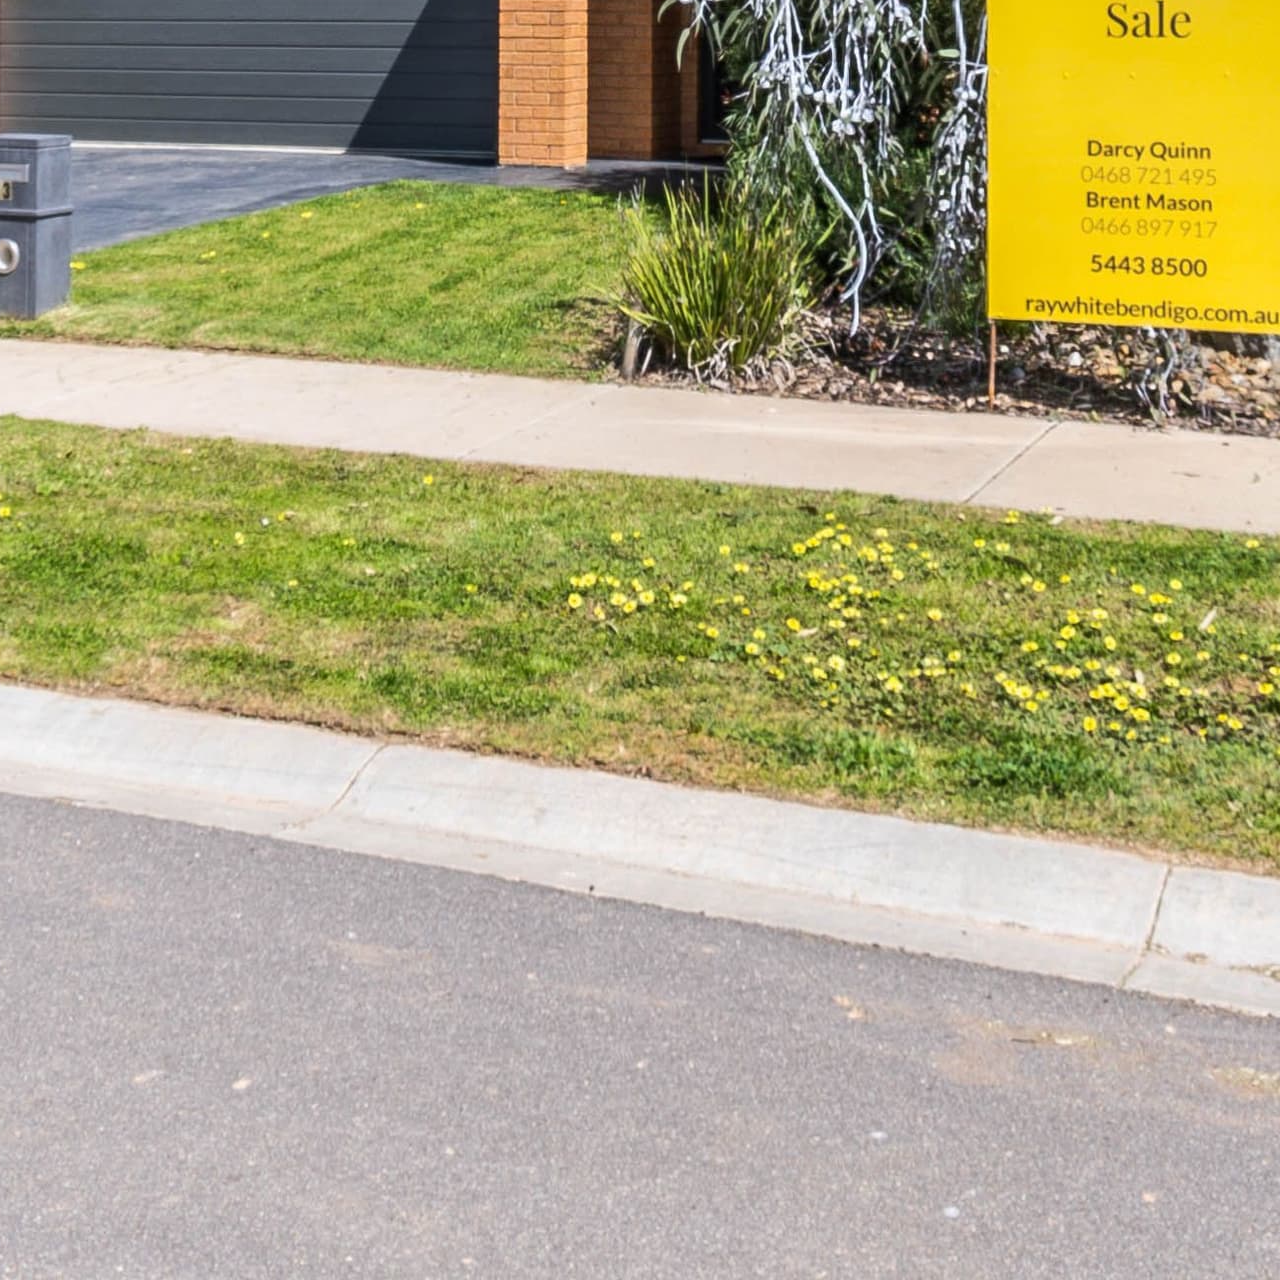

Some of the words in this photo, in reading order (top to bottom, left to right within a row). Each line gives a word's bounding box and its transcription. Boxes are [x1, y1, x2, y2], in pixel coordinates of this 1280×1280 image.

[1106, 0, 1192, 39] Sale
[1087, 140, 1144, 161] Darcy
[1150, 141, 1212, 161] Quinn
[1081, 165, 1131, 184] 0468
[1136, 167, 1173, 185] 721
[1179, 168, 1217, 186] 495
[1086, 191, 1141, 210] Brent
[1146, 193, 1213, 212] Mason
[1081, 217, 1132, 236] 0466
[1136, 218, 1174, 237] 897
[1180, 220, 1217, 239] 917
[1090, 254, 1146, 275] 5443
[1151, 257, 1208, 278] 8500
[1025, 296, 1280, 325] raywhitebendigo.com.au
